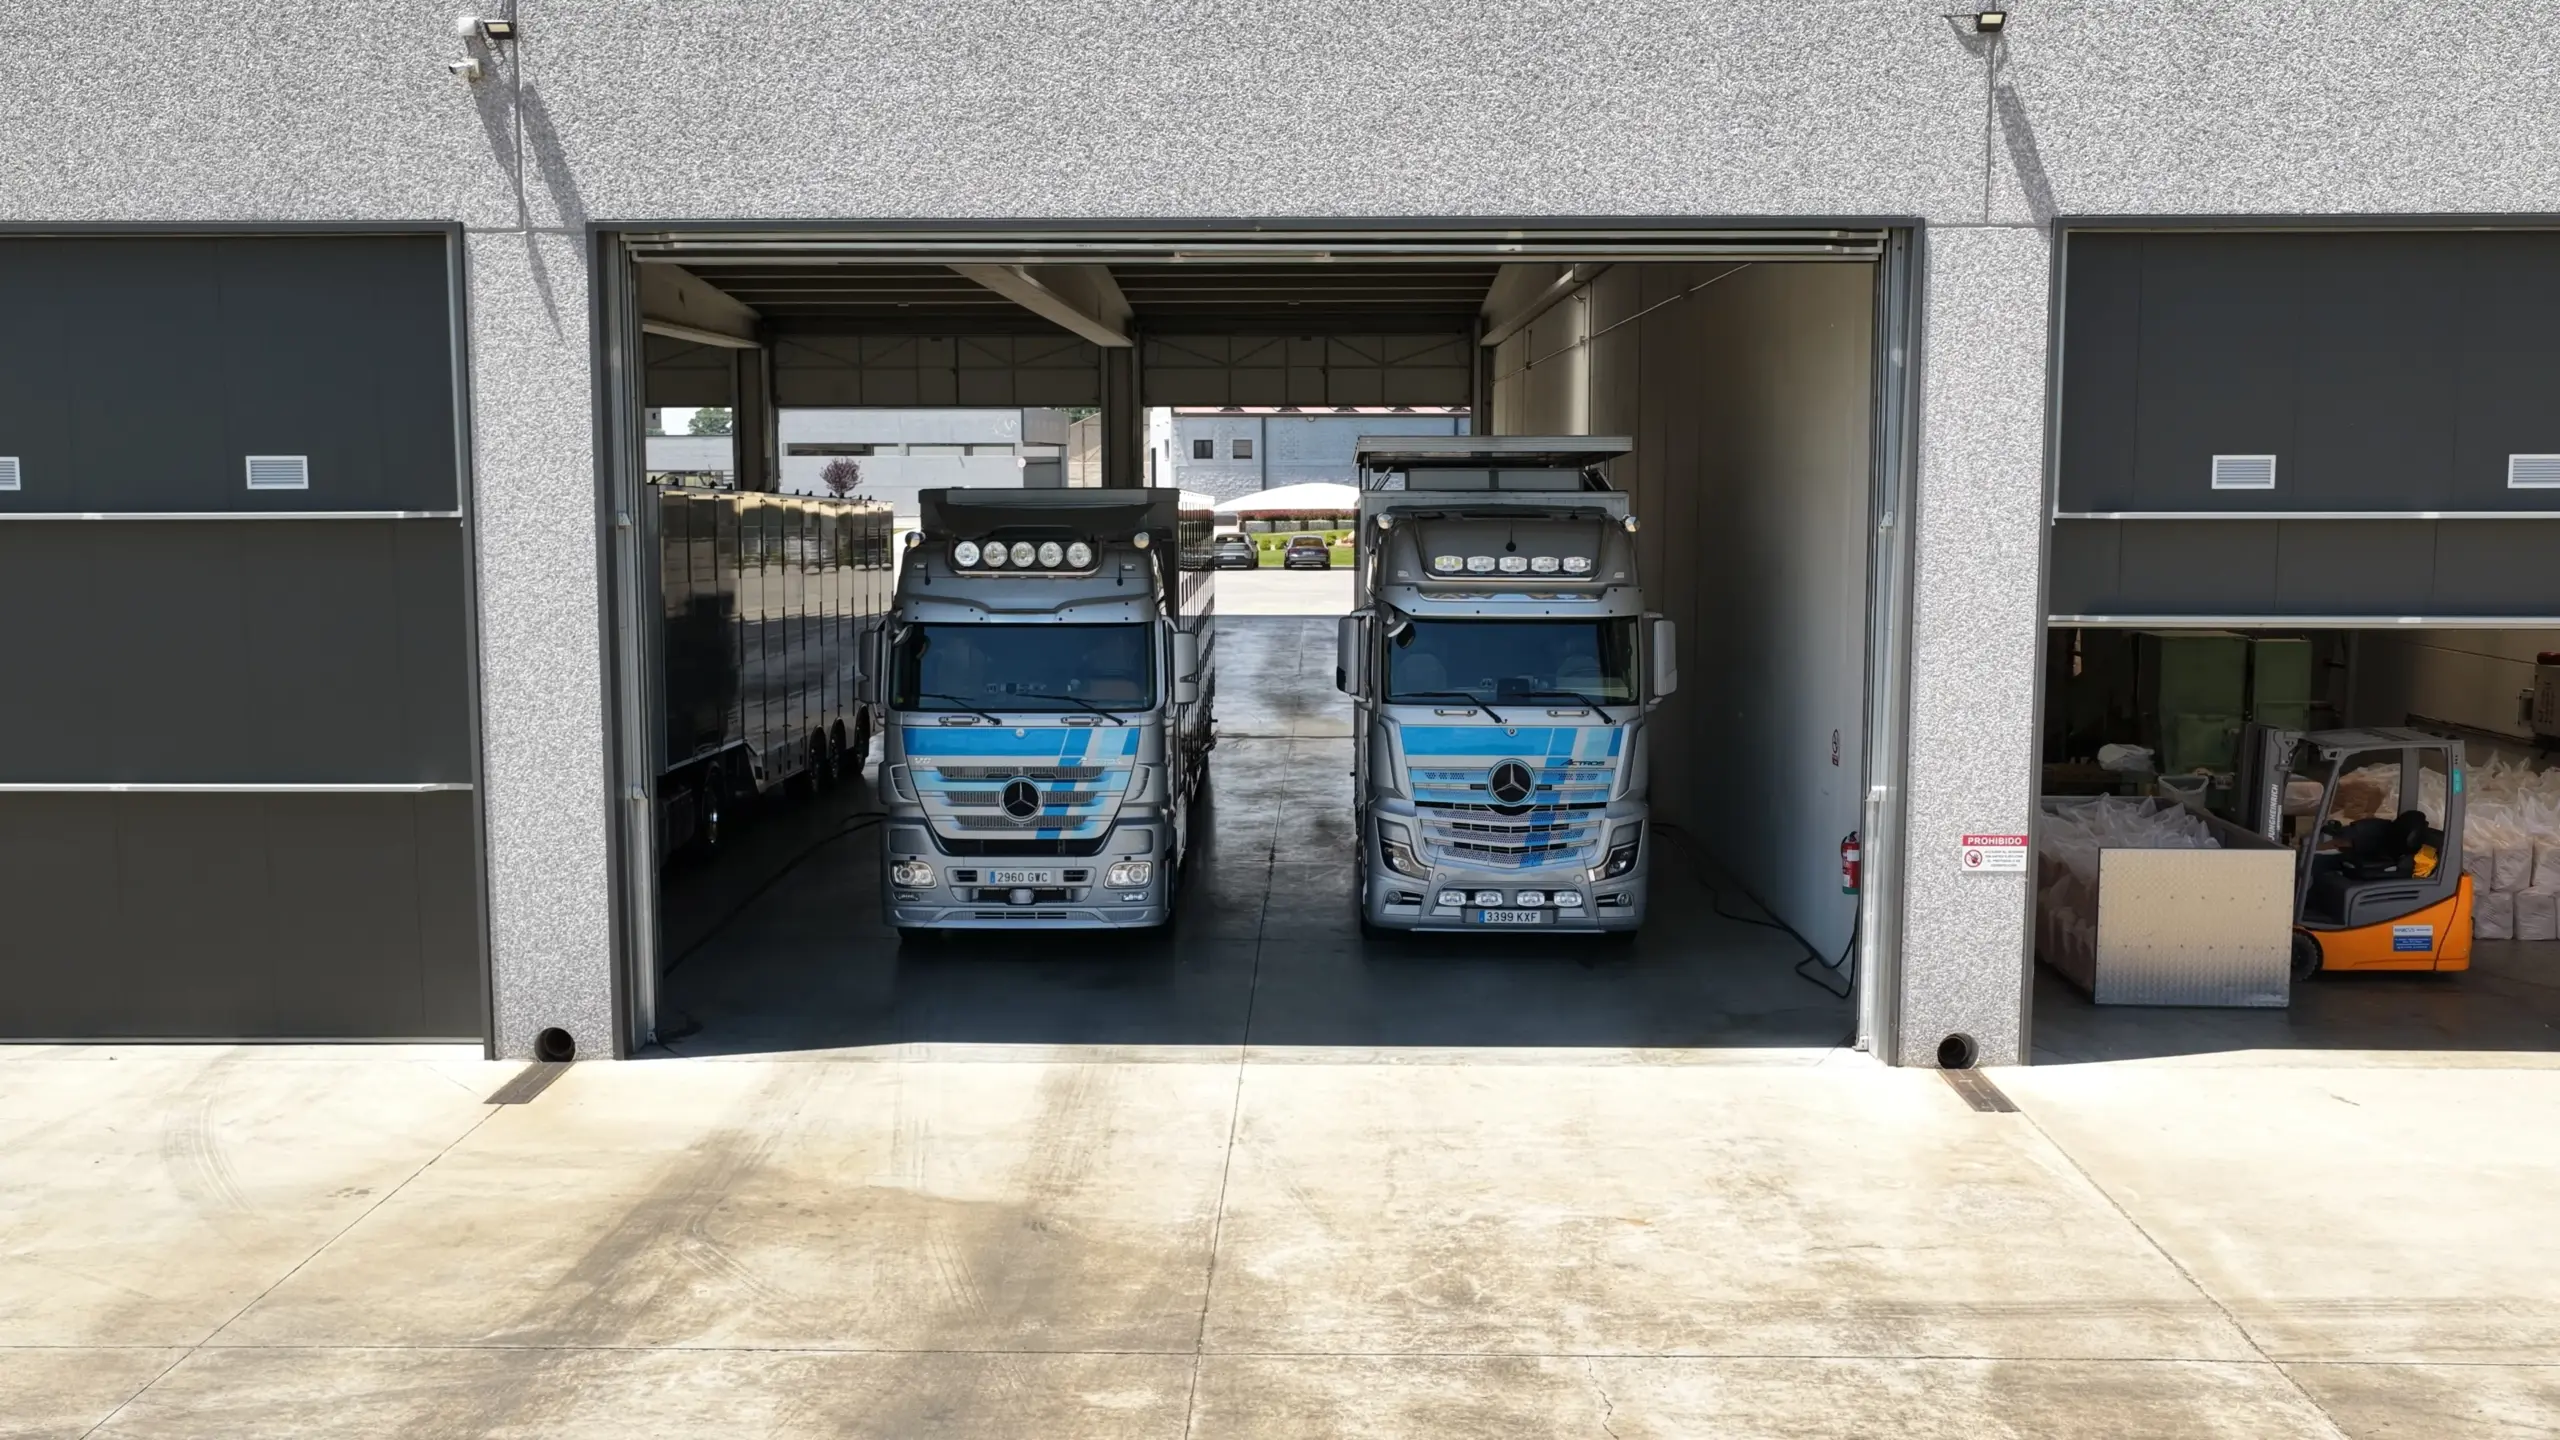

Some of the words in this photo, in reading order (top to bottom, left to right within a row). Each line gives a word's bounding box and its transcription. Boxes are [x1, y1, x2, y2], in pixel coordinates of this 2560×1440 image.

[2268, 783, 2279, 841] JUNGHEINRICH
[1967, 836, 2022, 846] PROHIBIDO
[997, 872, 1024, 883] 2960
[1486, 911, 1514, 922] 3399
[1516, 911, 1538, 923] KXF
